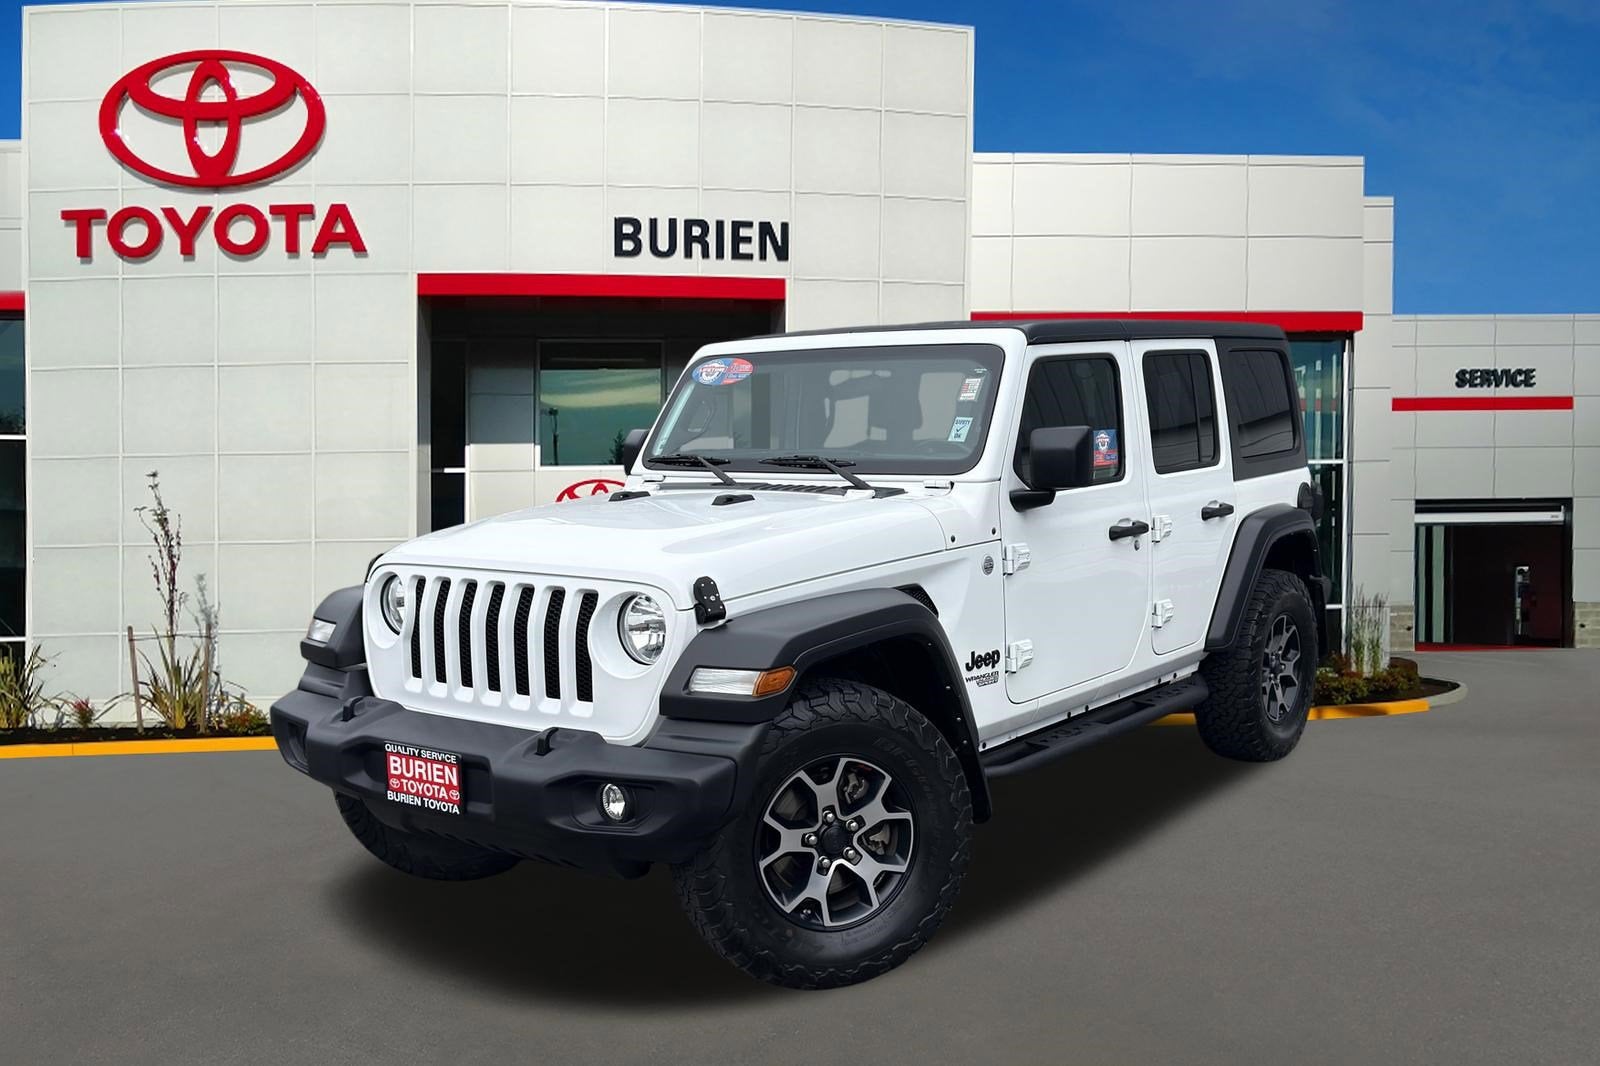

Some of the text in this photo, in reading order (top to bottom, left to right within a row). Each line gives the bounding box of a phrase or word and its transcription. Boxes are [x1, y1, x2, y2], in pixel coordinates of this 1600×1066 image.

[61, 203, 368, 259] TOYOTA
[614, 216, 790, 262] BURIEN
[1455, 368, 1537, 388] SERVICE
[965, 649, 1000, 672] Jeep
[965, 671, 999, 682] WRANGLER
[384, 743, 457, 764] QUALITY SERVICE
[389, 755, 458, 786] BURIEN
[400, 778, 449, 800] TOYOTA
[386, 790, 460, 815] BURIEN TOYOTA
